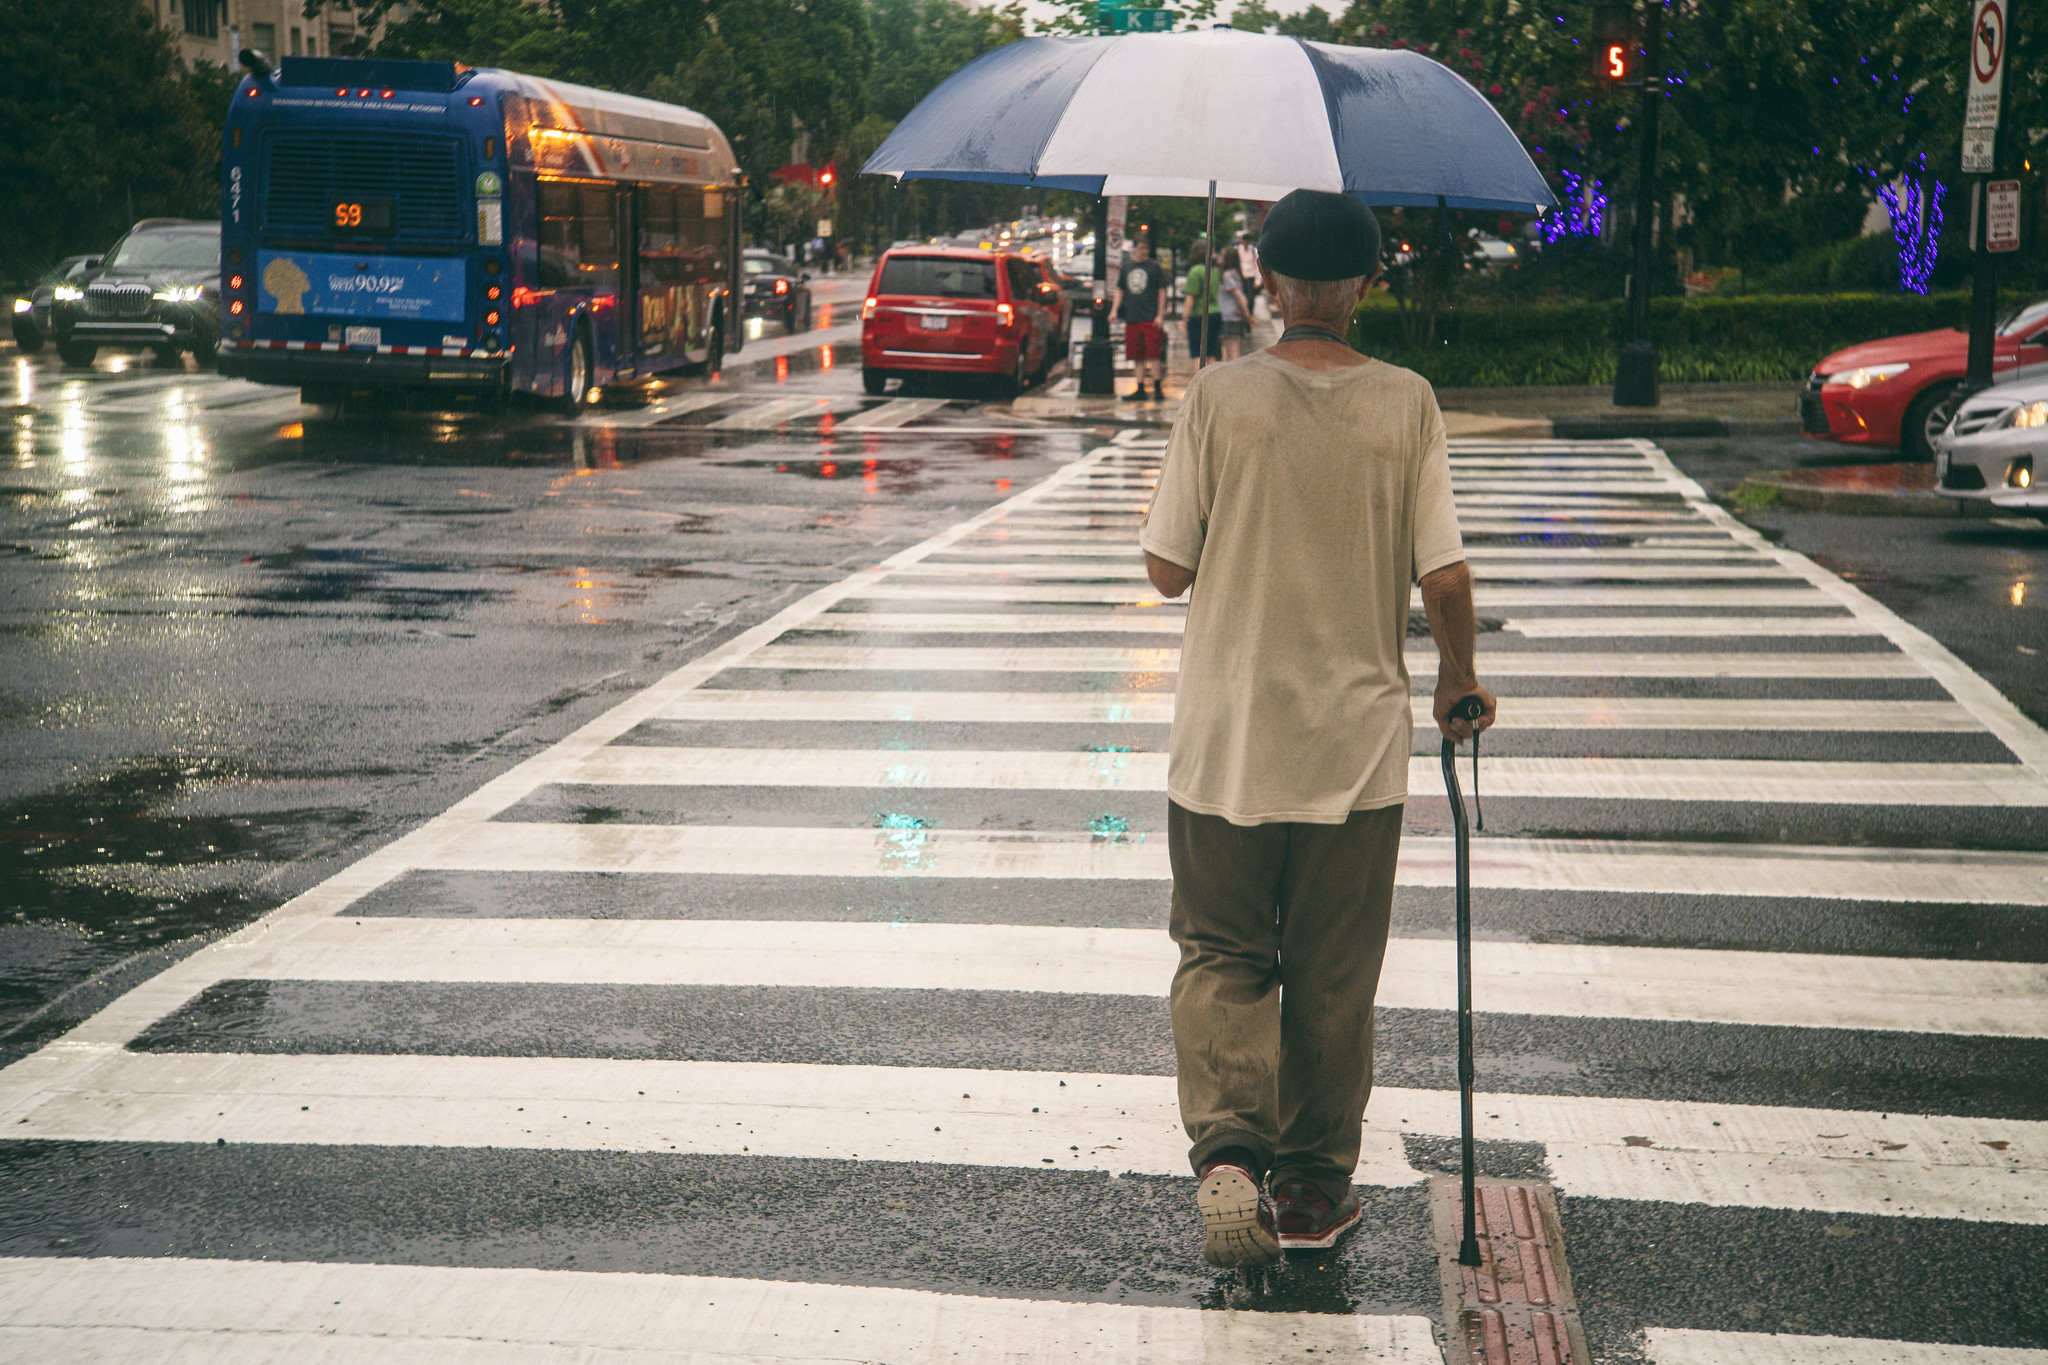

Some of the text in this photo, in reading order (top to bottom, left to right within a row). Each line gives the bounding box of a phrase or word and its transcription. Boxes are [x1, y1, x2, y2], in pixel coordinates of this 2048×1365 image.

[1127, 11, 1142, 28] K
[1609, 46, 1624, 77] 5
[272, 98, 447, 113] WASHINGTON METROPOLITAN AREA TRANSIT AUTHORITY
[230, 166, 242, 223] 6471
[335, 203, 362, 227] S9
[355, 274, 390, 293] 90.9
